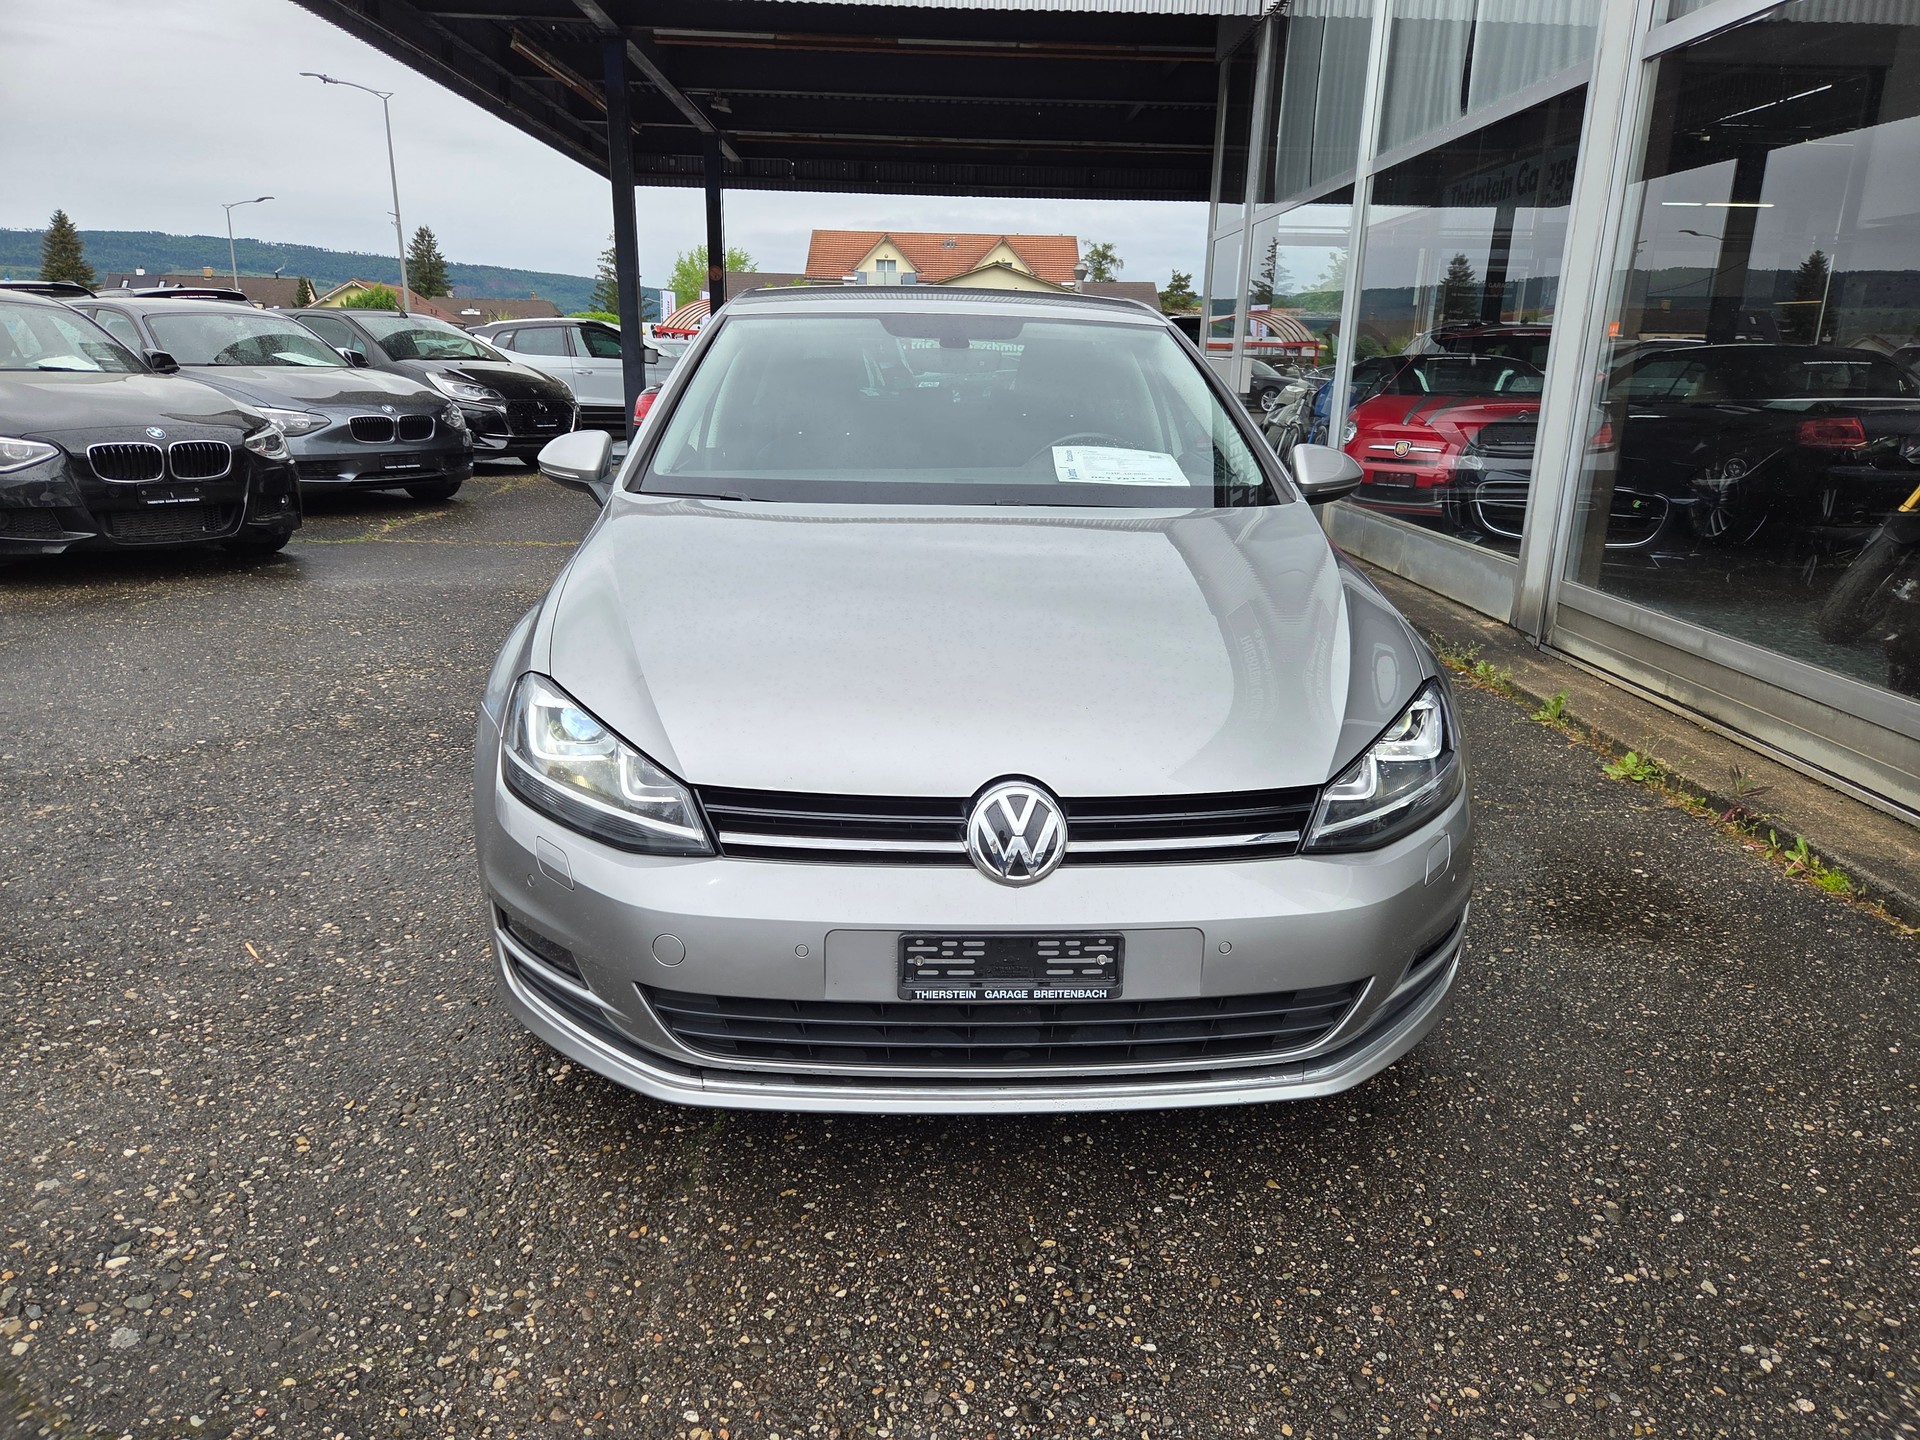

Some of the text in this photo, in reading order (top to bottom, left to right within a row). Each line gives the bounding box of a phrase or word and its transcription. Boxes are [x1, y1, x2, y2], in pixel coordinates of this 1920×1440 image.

[1517, 155, 1577, 196] Gaage
[974, 785, 1063, 881] VW
[914, 989, 1107, 999] THIERSTEIN GARAGE BREITENBACH
